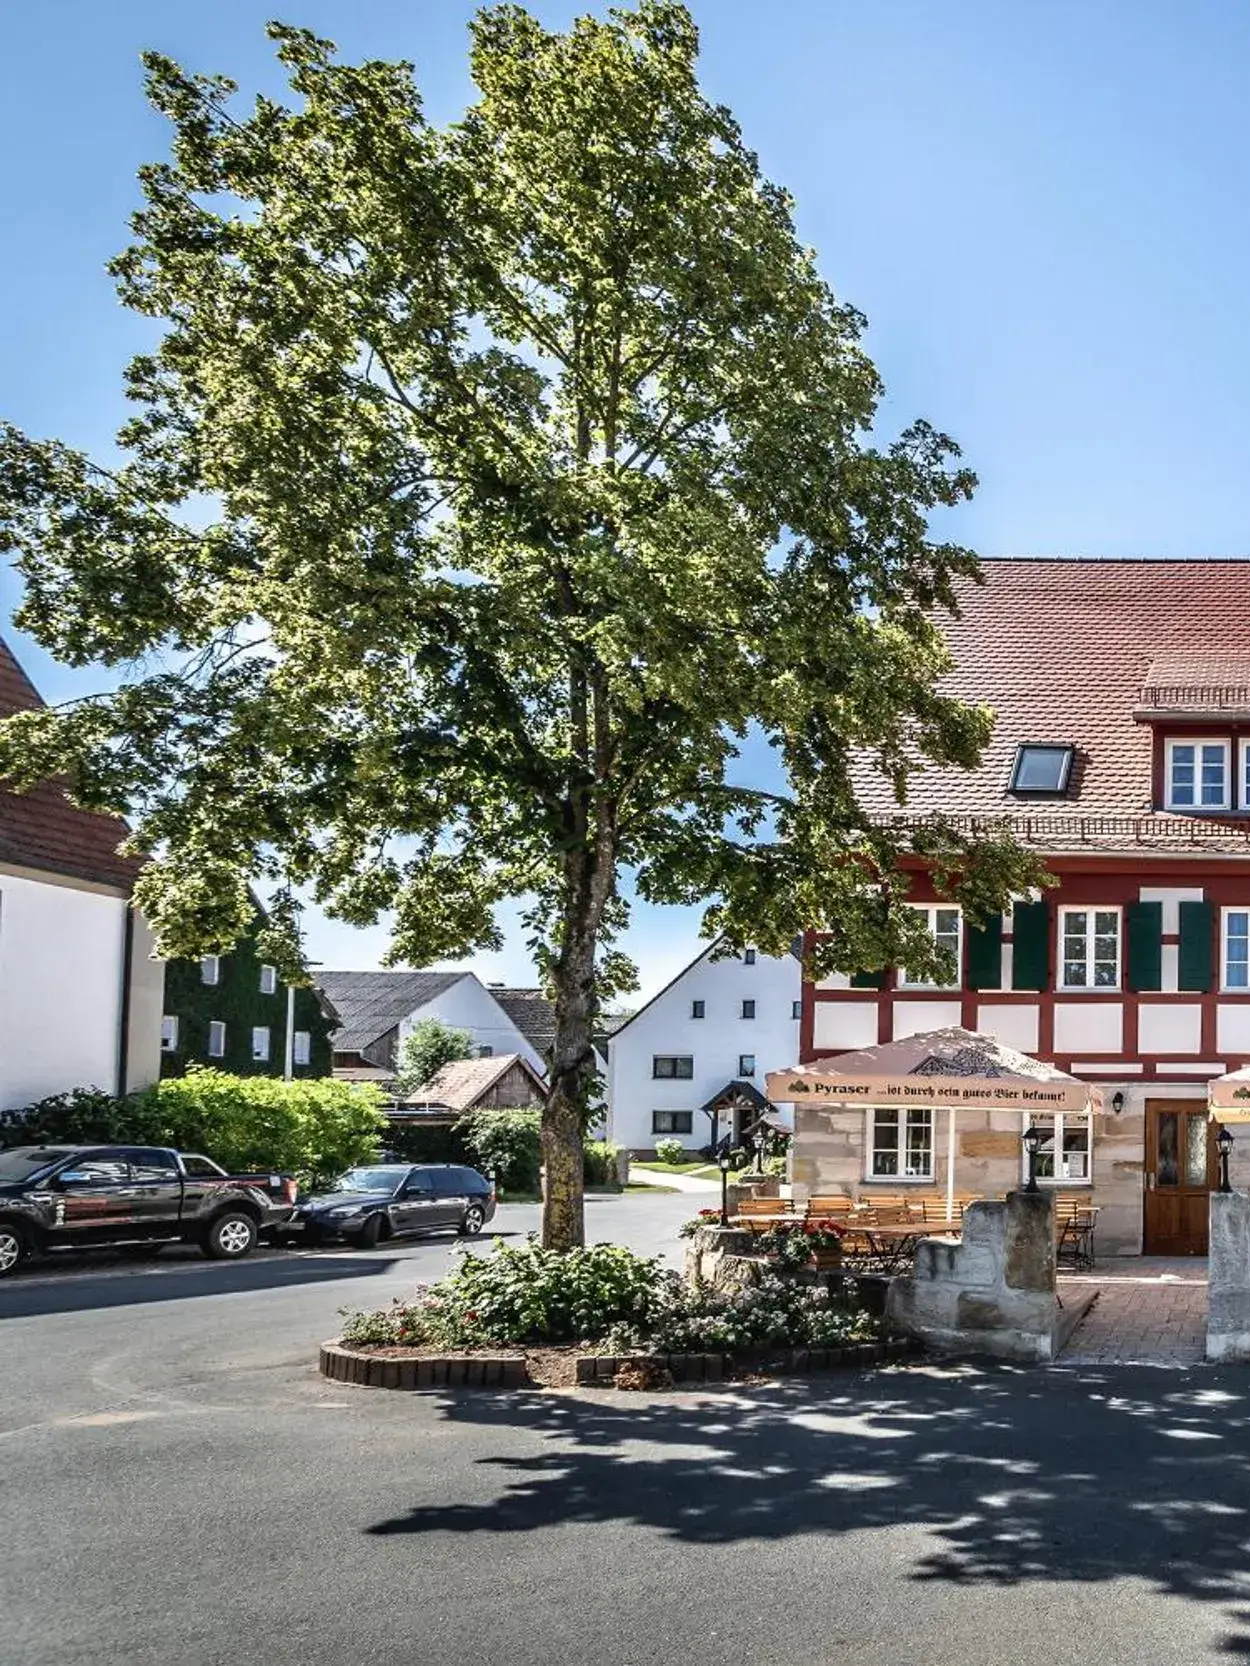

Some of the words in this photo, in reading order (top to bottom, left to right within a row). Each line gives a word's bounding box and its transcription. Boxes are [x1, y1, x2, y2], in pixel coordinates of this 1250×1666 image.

[815, 1083, 870, 1096] Pyraser
[904, 1085, 935, 1097] durch
[938, 1086, 959, 1096] sein
[962, 1089, 991, 1100] gutes
[994, 1088, 1019, 1099] Bier
[1022, 1089, 1065, 1101] bekannt!
